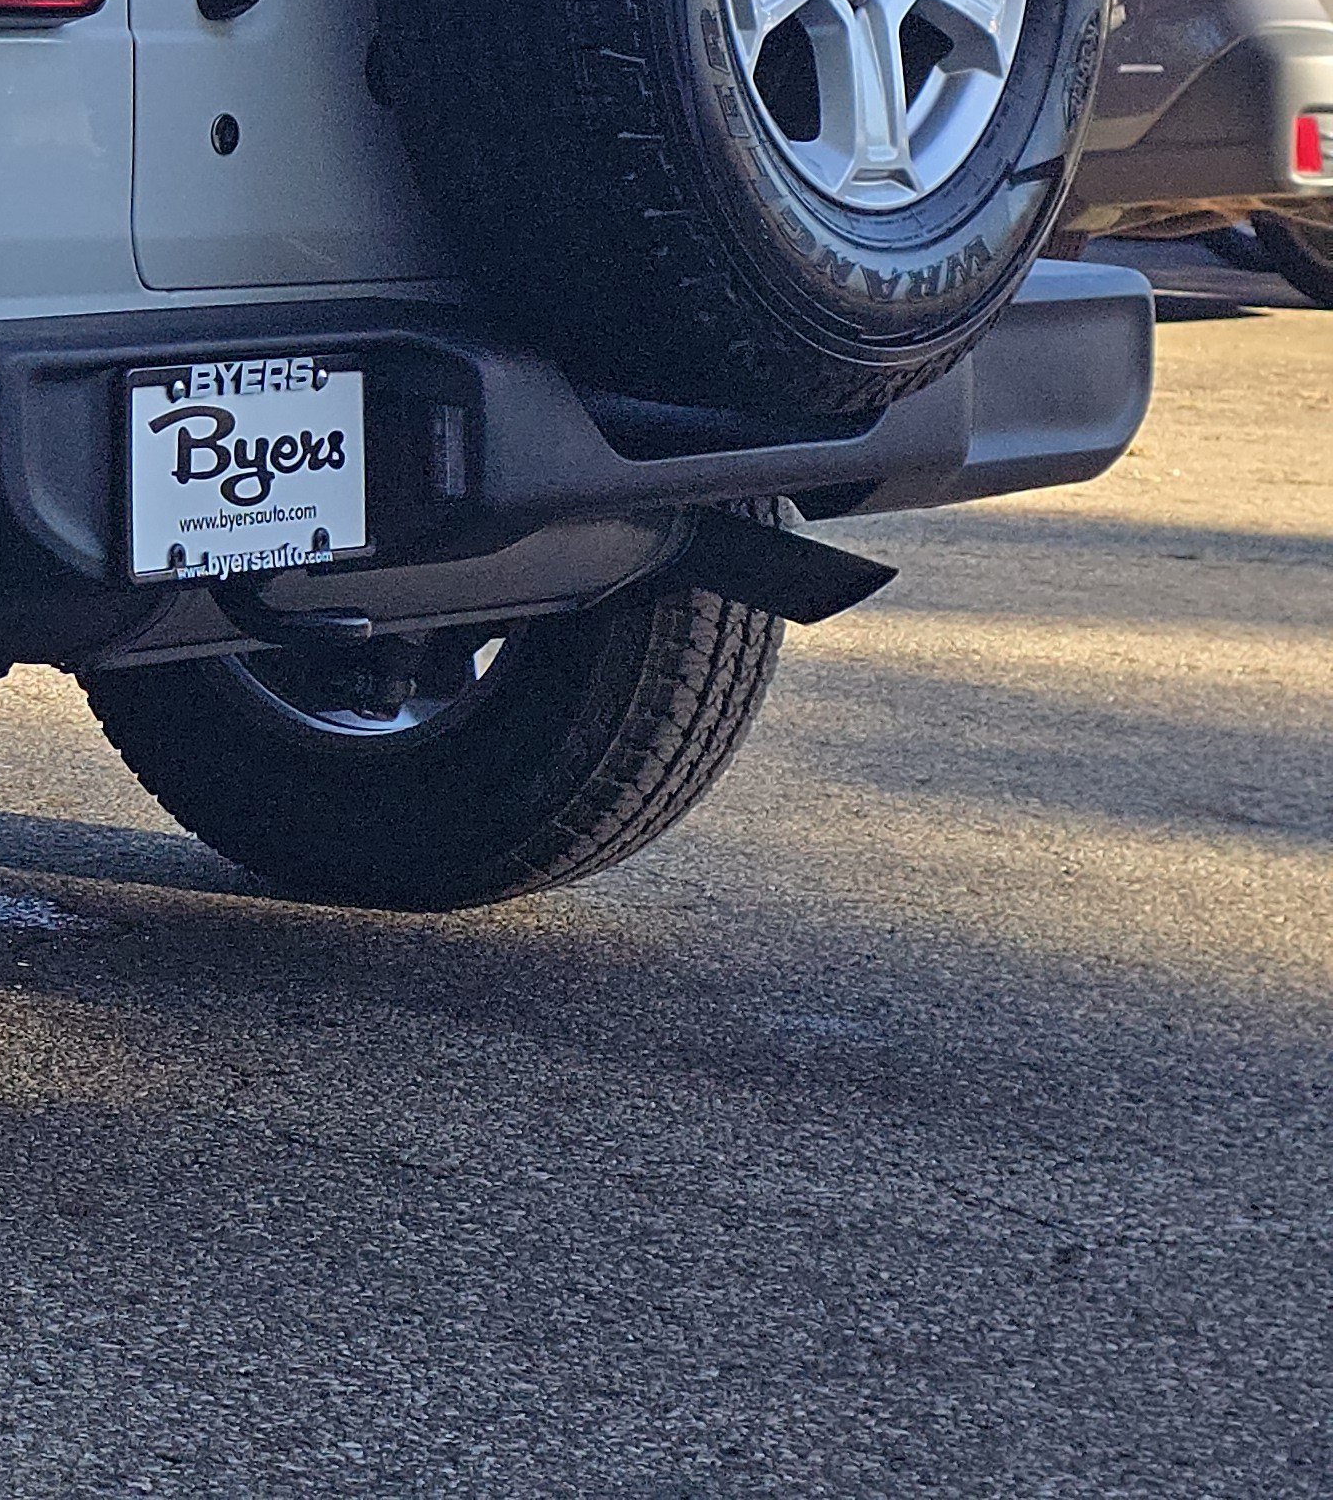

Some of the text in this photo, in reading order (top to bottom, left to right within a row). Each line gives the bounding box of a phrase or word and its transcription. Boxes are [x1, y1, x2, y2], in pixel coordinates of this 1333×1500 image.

[189, 357, 315, 398] BYERS
[148, 405, 345, 506] Byers
[179, 503, 317, 533] www.byersauto.com
[176, 542, 333, 580] www.byersauto.com
